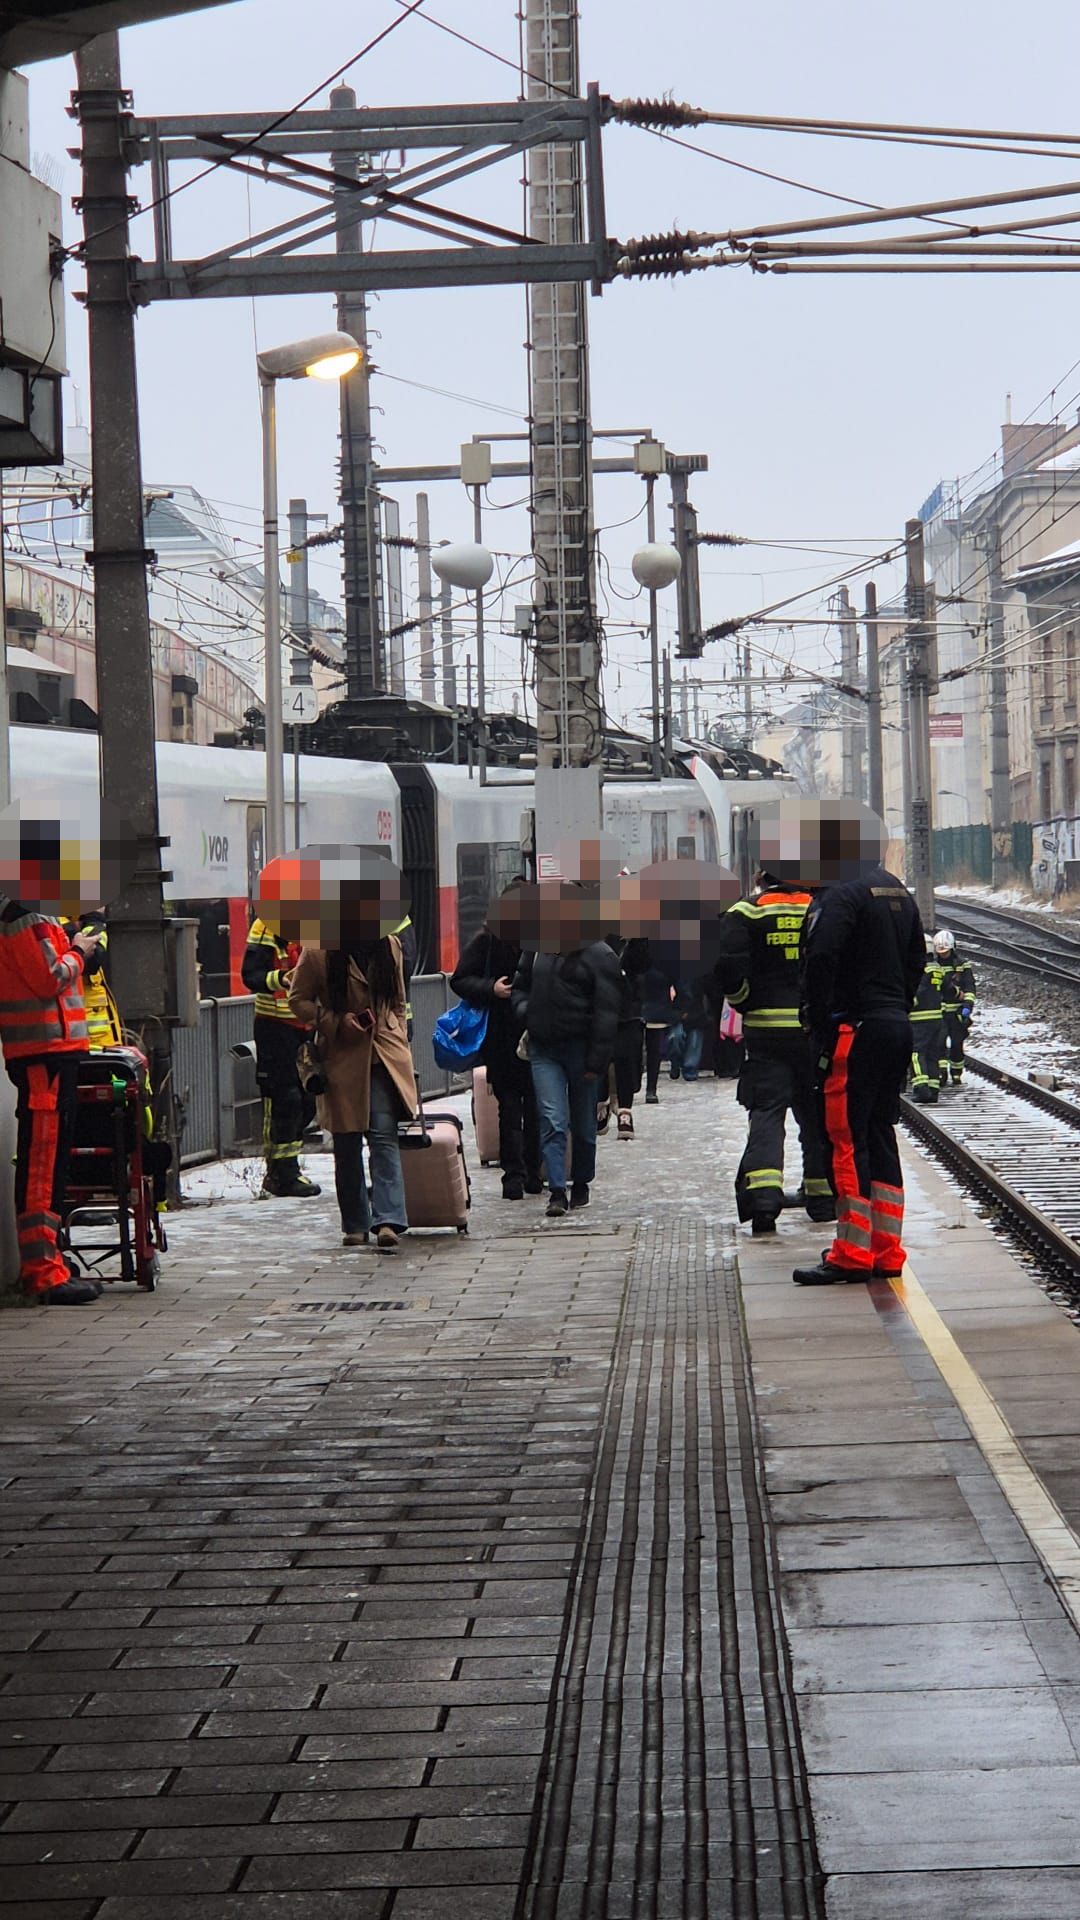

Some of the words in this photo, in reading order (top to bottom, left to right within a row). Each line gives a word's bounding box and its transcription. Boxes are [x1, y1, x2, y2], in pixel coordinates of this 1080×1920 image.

[292, 691, 305, 716] 4
[208, 835, 228, 862] VOR
[785, 947, 799, 960] WI
